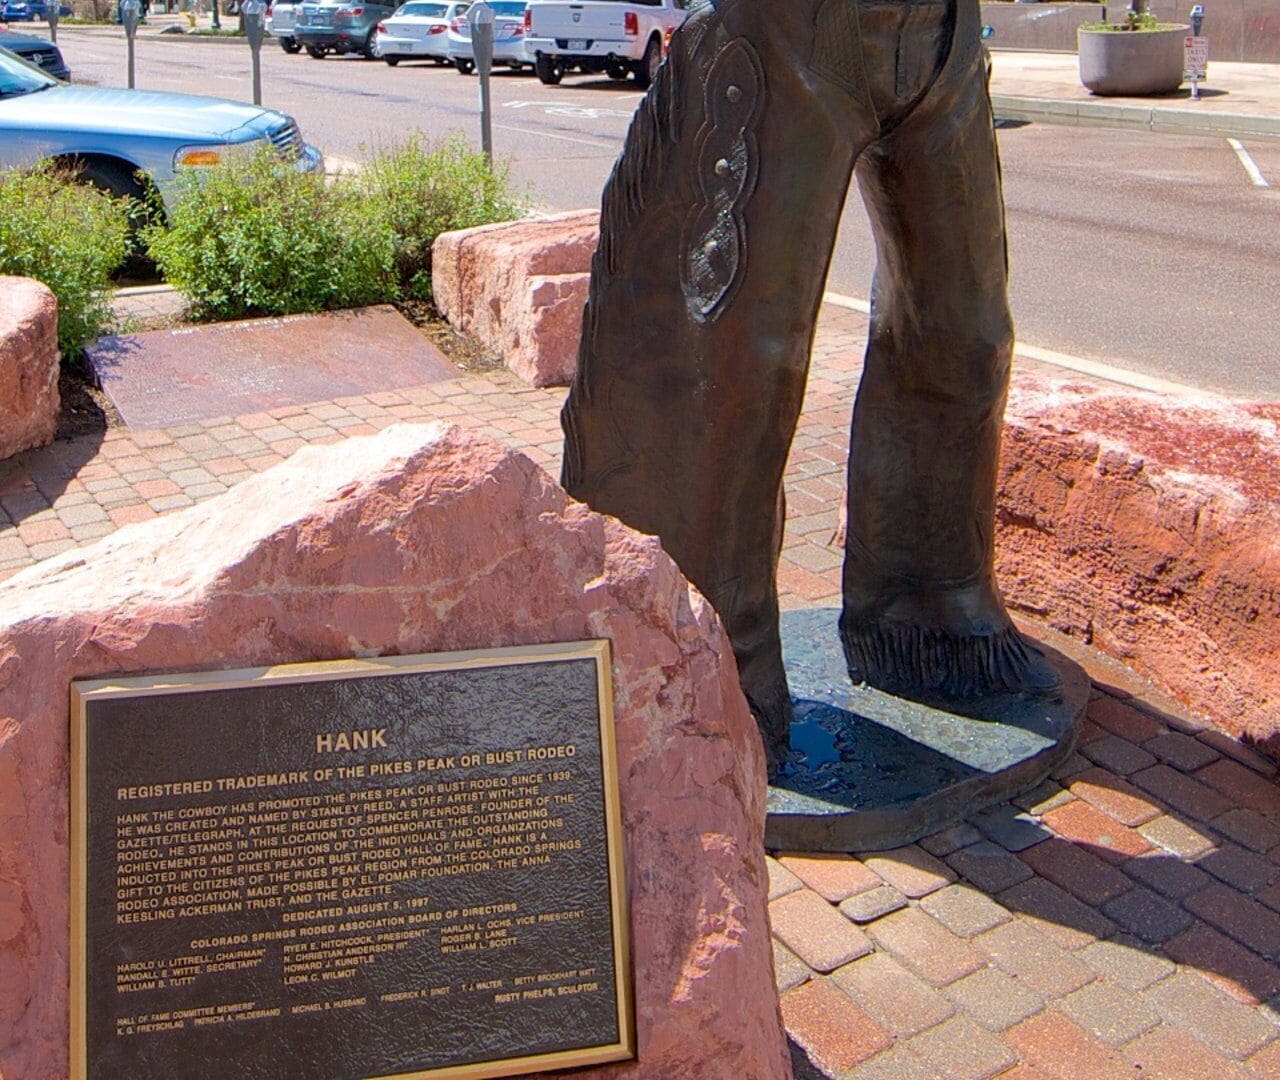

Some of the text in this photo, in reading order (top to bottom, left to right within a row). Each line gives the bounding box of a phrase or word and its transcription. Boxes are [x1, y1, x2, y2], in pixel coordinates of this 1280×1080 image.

[316, 729, 388, 753] HANK
[117, 746, 576, 800] REGISTERED TRADEMARK OF THE PIKES PEAK OR BUST RODEO
[116, 812, 148, 824] HANK
[151, 810, 174, 821] THE
[178, 805, 227, 818] COWBOY
[231, 802, 254, 813] HAS
[258, 796, 320, 810] PROMOTED
[324, 794, 345, 804] THE
[349, 790, 382, 802] PIKES
[385, 787, 414, 798] PEAK
[417, 785, 435, 795] OR
[435, 782, 464, 794] BUST
[470, 778, 508, 791] RODEO
[511, 775, 543, 787] SINCE
[116, 827, 132, 836] HE
[136, 824, 160, 834] WAS
[165, 819, 217, 831] CREATED
[221, 816, 244, 826] AND
[248, 812, 288, 823] NAMED
[292, 810, 306, 819] BY
[310, 805, 358, 817] STANLEY
[399, 800, 406, 808] A
[410, 797, 442, 807] STAFF
[447, 793, 483, 804] ARTIST
[487, 789, 518, 800] WITH
[517, 787, 538, 797] THE
[248, 826, 260, 836] AT
[265, 823, 286, 834] THE
[291, 817, 343, 831] REQUEST
[347, 816, 362, 826] OF
[366, 810, 418, 824] SPENCER
[480, 798, 532, 812] FOUNDER
[535, 797, 550, 807] OF
[554, 794, 575, 805] THE
[116, 809, 548, 862] RODEO. HE STANDS IN THIS LOCATION TO COMMEMORATE THE OUTSTANDING
[116, 819, 563, 873] ACHIEVEMENTS AND CONTRIBUTIONS OF THE INDIVIDUALS AND ORGANIZATIONS
[116, 840, 581, 899] GIFT TO THE CITIZENS OF THE PIKES PEAK REGION FROM THE COLORADO SPRINGS
[117, 833, 549, 886] INDUCTED INTO THE PIKES PEAK OR BUST RODEO HALL OF FAME. HANK IS A
[116, 899, 158, 911] RODEO
[246, 886, 278, 897] MADE
[283, 879, 338, 893] POSSIBLE
[341, 877, 356, 887] BY
[358, 875, 374, 885] EL
[378, 870, 417, 883] POMAR
[497, 859, 517, 870] THE
[522, 856, 551, 867] ANNA
[116, 909, 175, 924] KEESLING
[178, 902, 242, 917] ACKERMAN
[288, 895, 312, 905] AND
[317, 892, 338, 902] THE
[190, 904, 517, 949] COLORADO SPRINGS RODEO ASSOCIATION BOARD OF DIRECTORS
[282, 906, 343, 921] DEDICATED
[346, 902, 388, 914] AUGUST
[392, 901, 402, 910] 5,
[116, 961, 155, 973] HAROLD
[116, 970, 158, 983] RANDALL
[116, 982, 155, 993] WILLIAM
[283, 962, 322, 974] HOWARD
[283, 974, 308, 985] LEON
[321, 970, 355, 981] WILMOT
